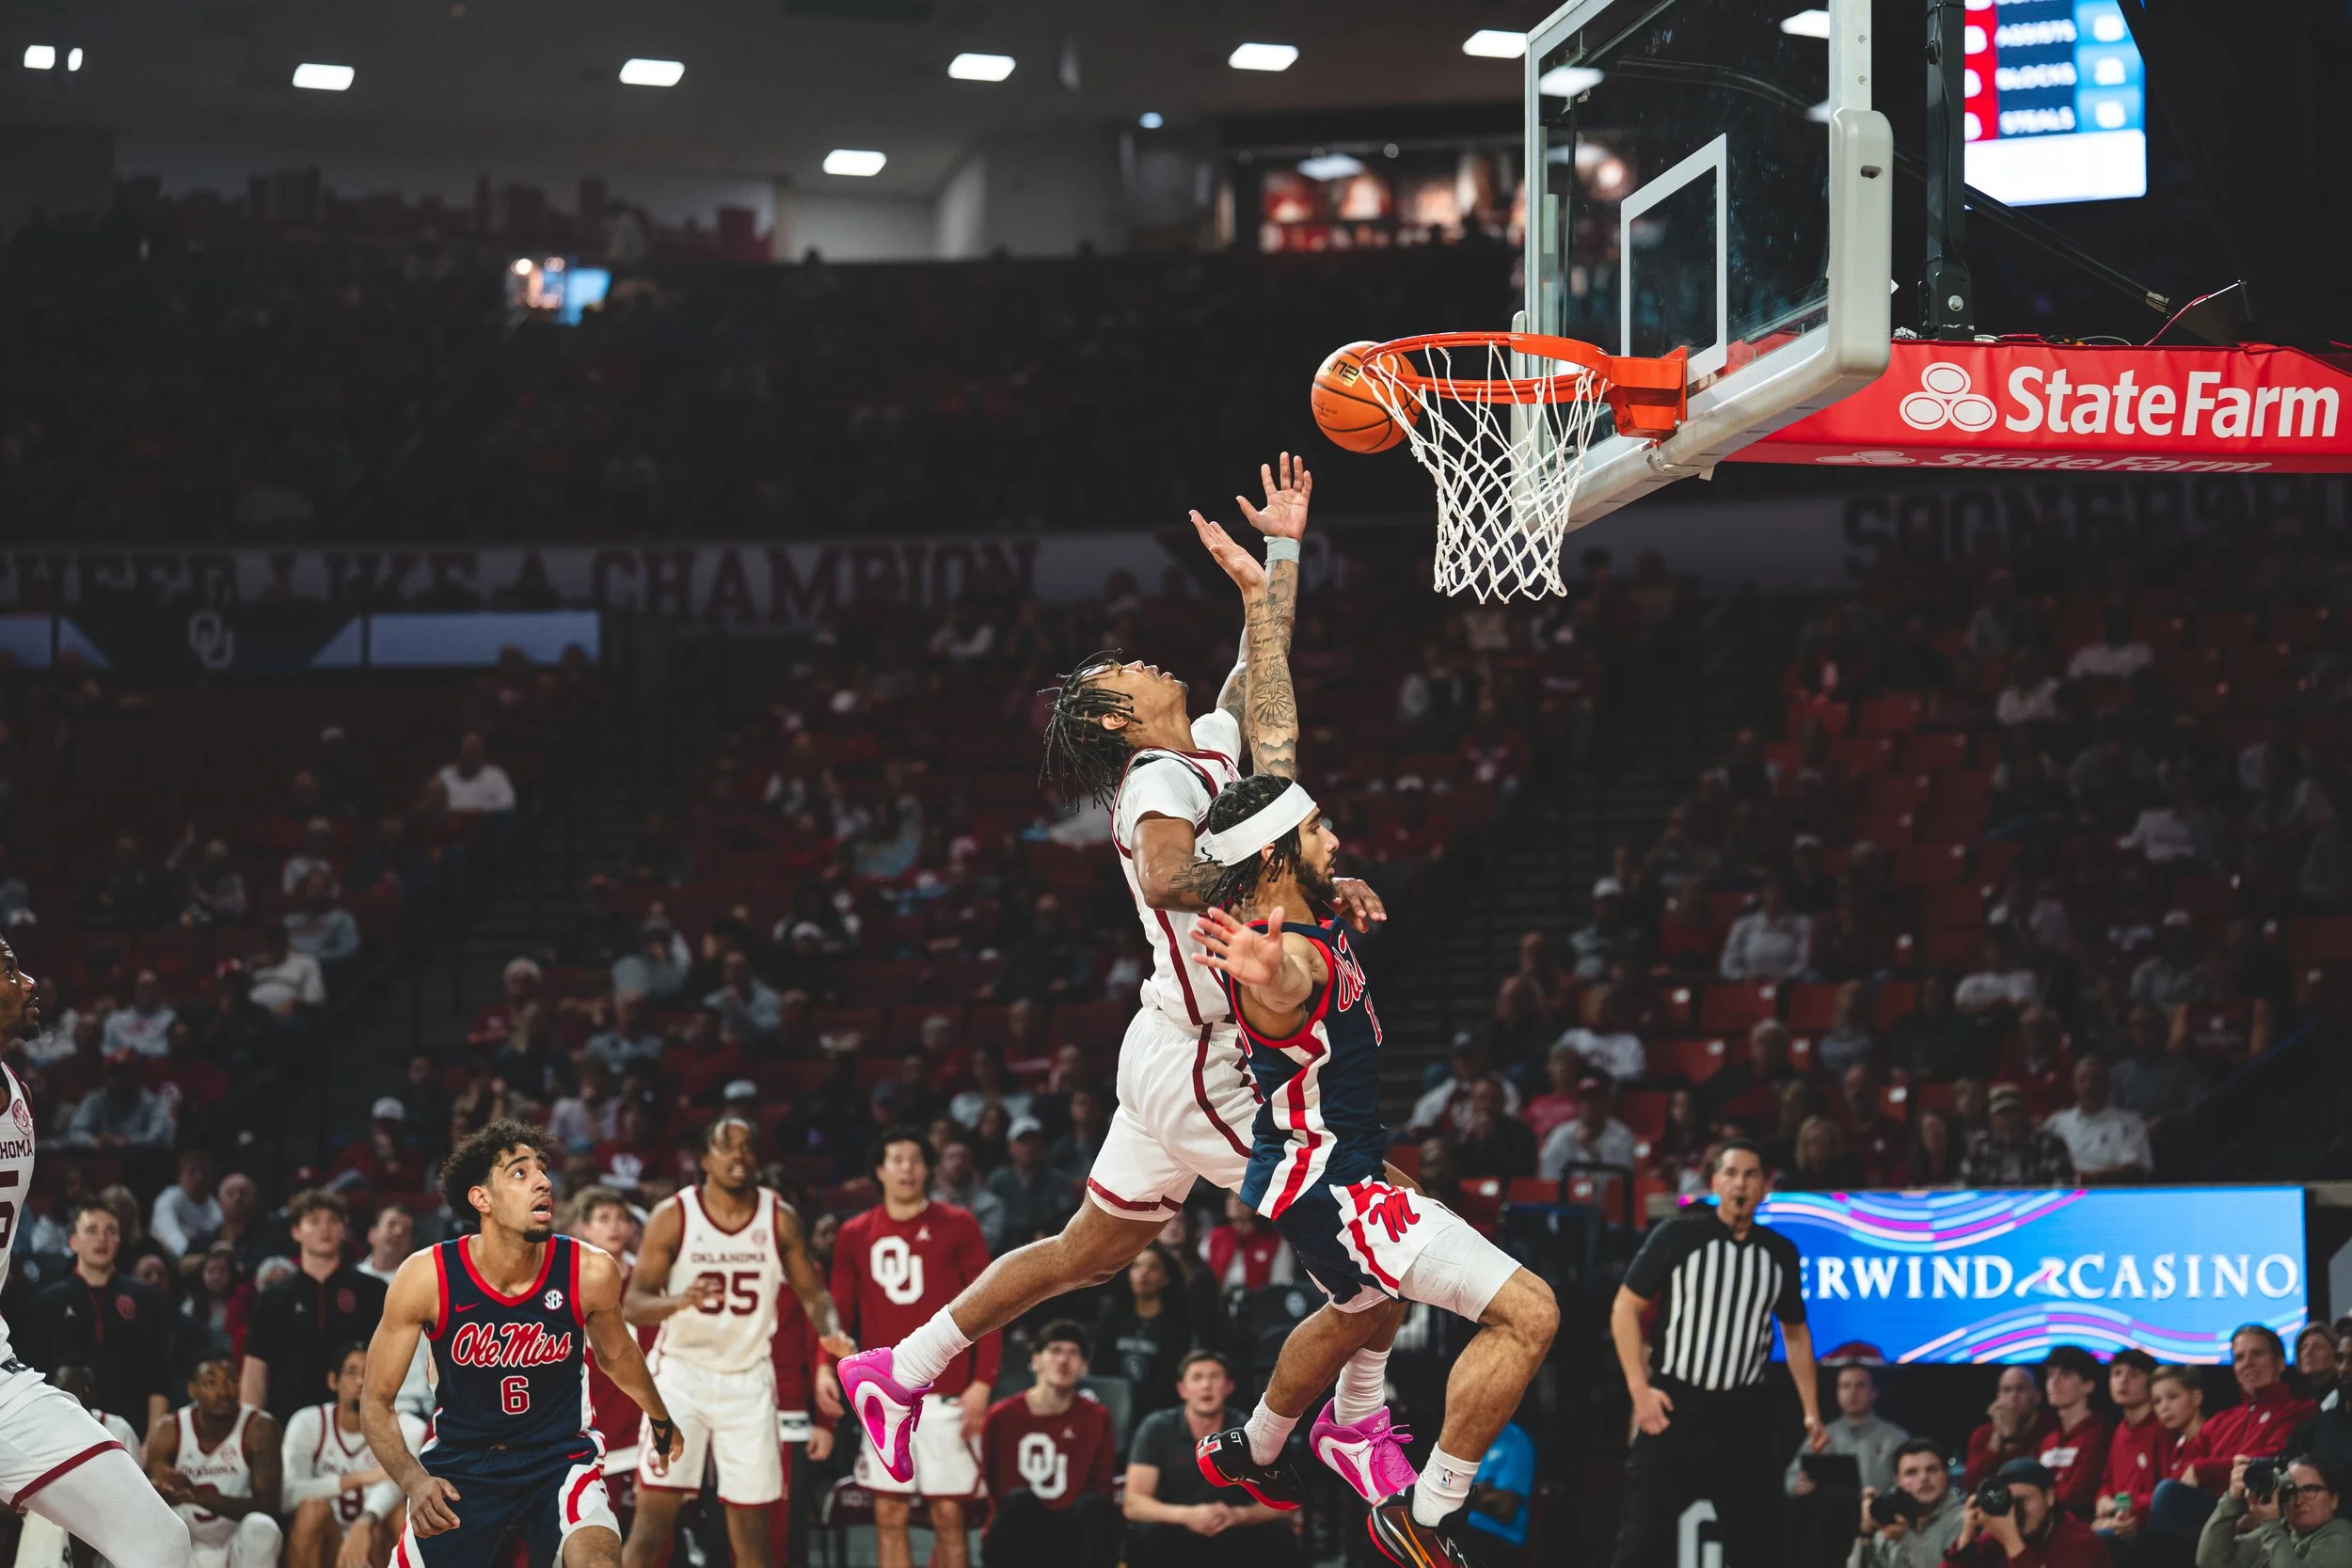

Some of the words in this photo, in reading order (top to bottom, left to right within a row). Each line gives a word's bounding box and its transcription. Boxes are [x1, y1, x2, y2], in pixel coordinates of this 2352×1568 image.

[870, 1235, 925, 1306] OU
[2067, 1251, 2298, 1301] CASINO
[545, 1290, 564, 1310] SEC
[452, 1322, 501, 1368] Ole
[500, 1322, 574, 1369] Miss
[501, 1375, 531, 1416] 6
[1018, 1432, 1069, 1500] OU
